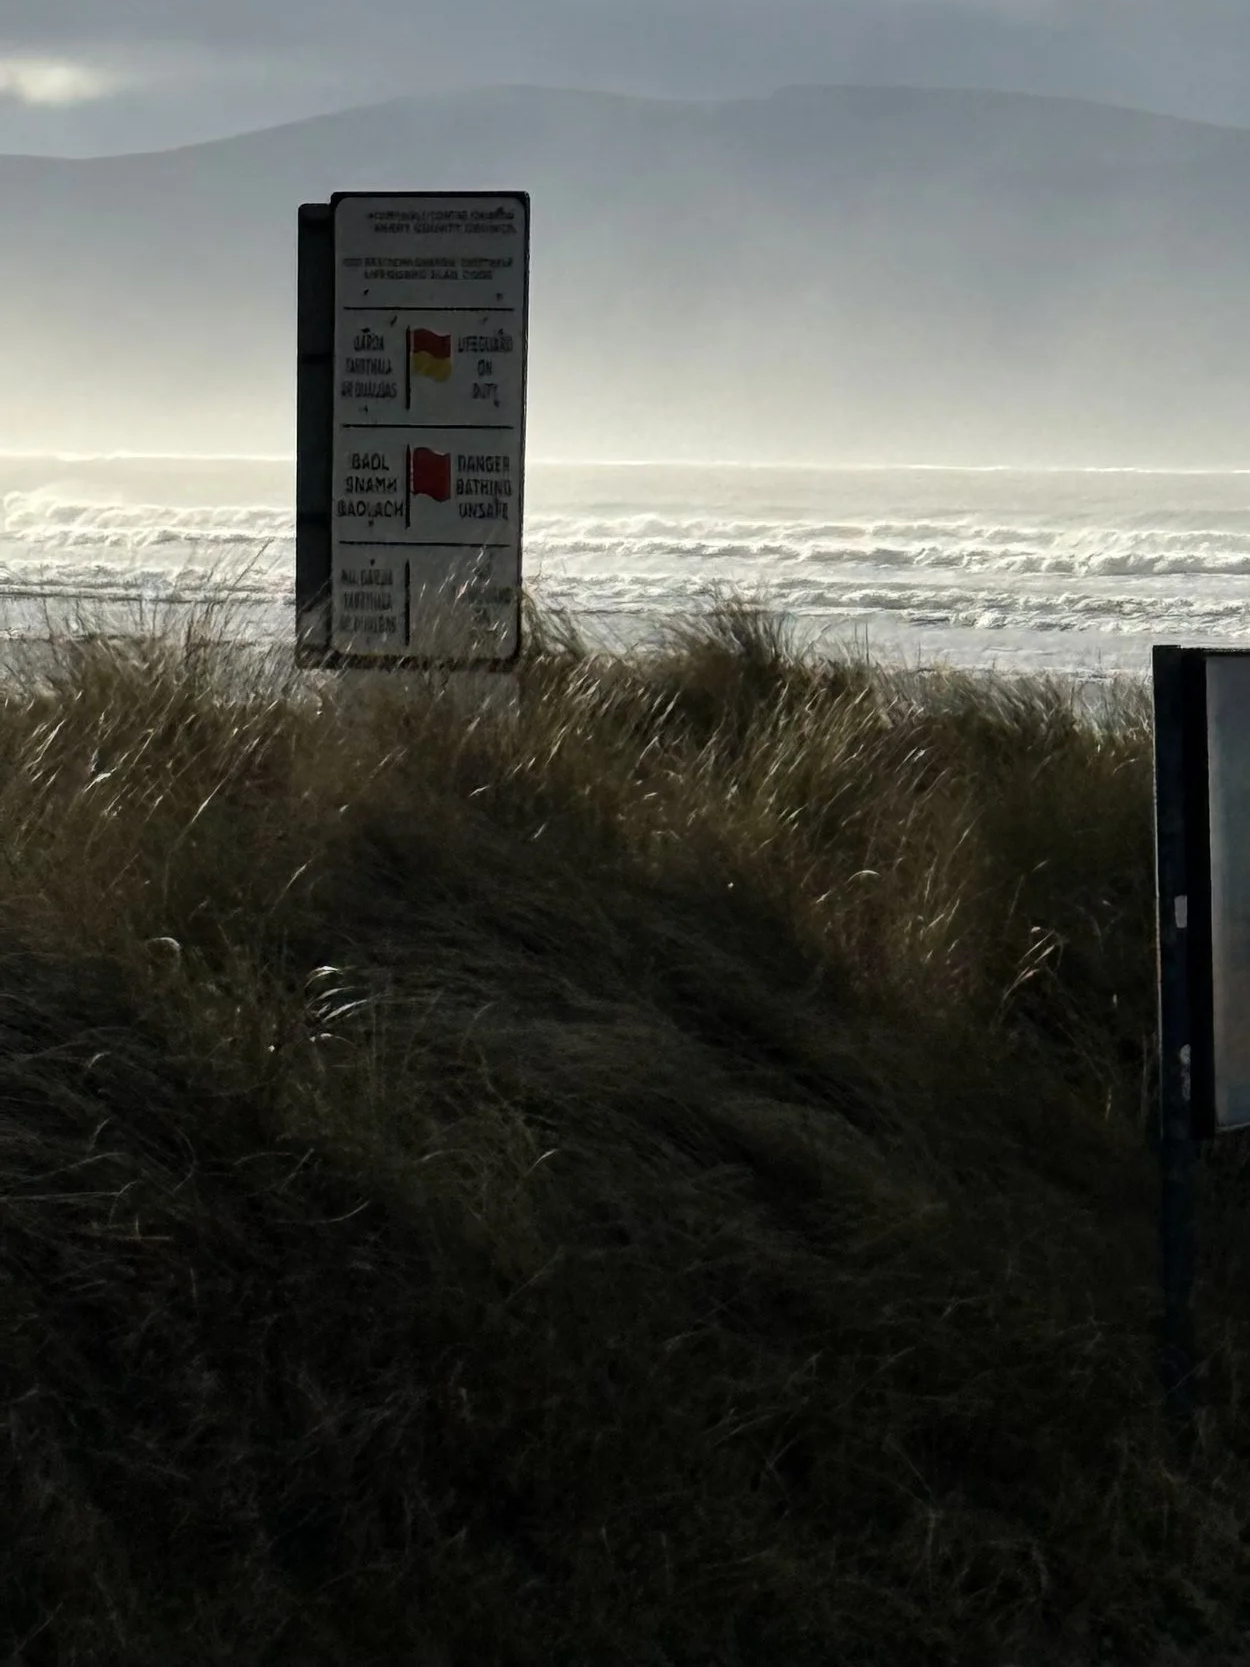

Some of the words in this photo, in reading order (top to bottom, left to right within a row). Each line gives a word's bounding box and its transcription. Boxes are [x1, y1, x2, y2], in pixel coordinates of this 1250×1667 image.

[351, 452, 390, 471] BAOL
[457, 454, 511, 473] DANGER
[456, 478, 512, 496] BATHING
[458, 501, 509, 520] UNSAFE
